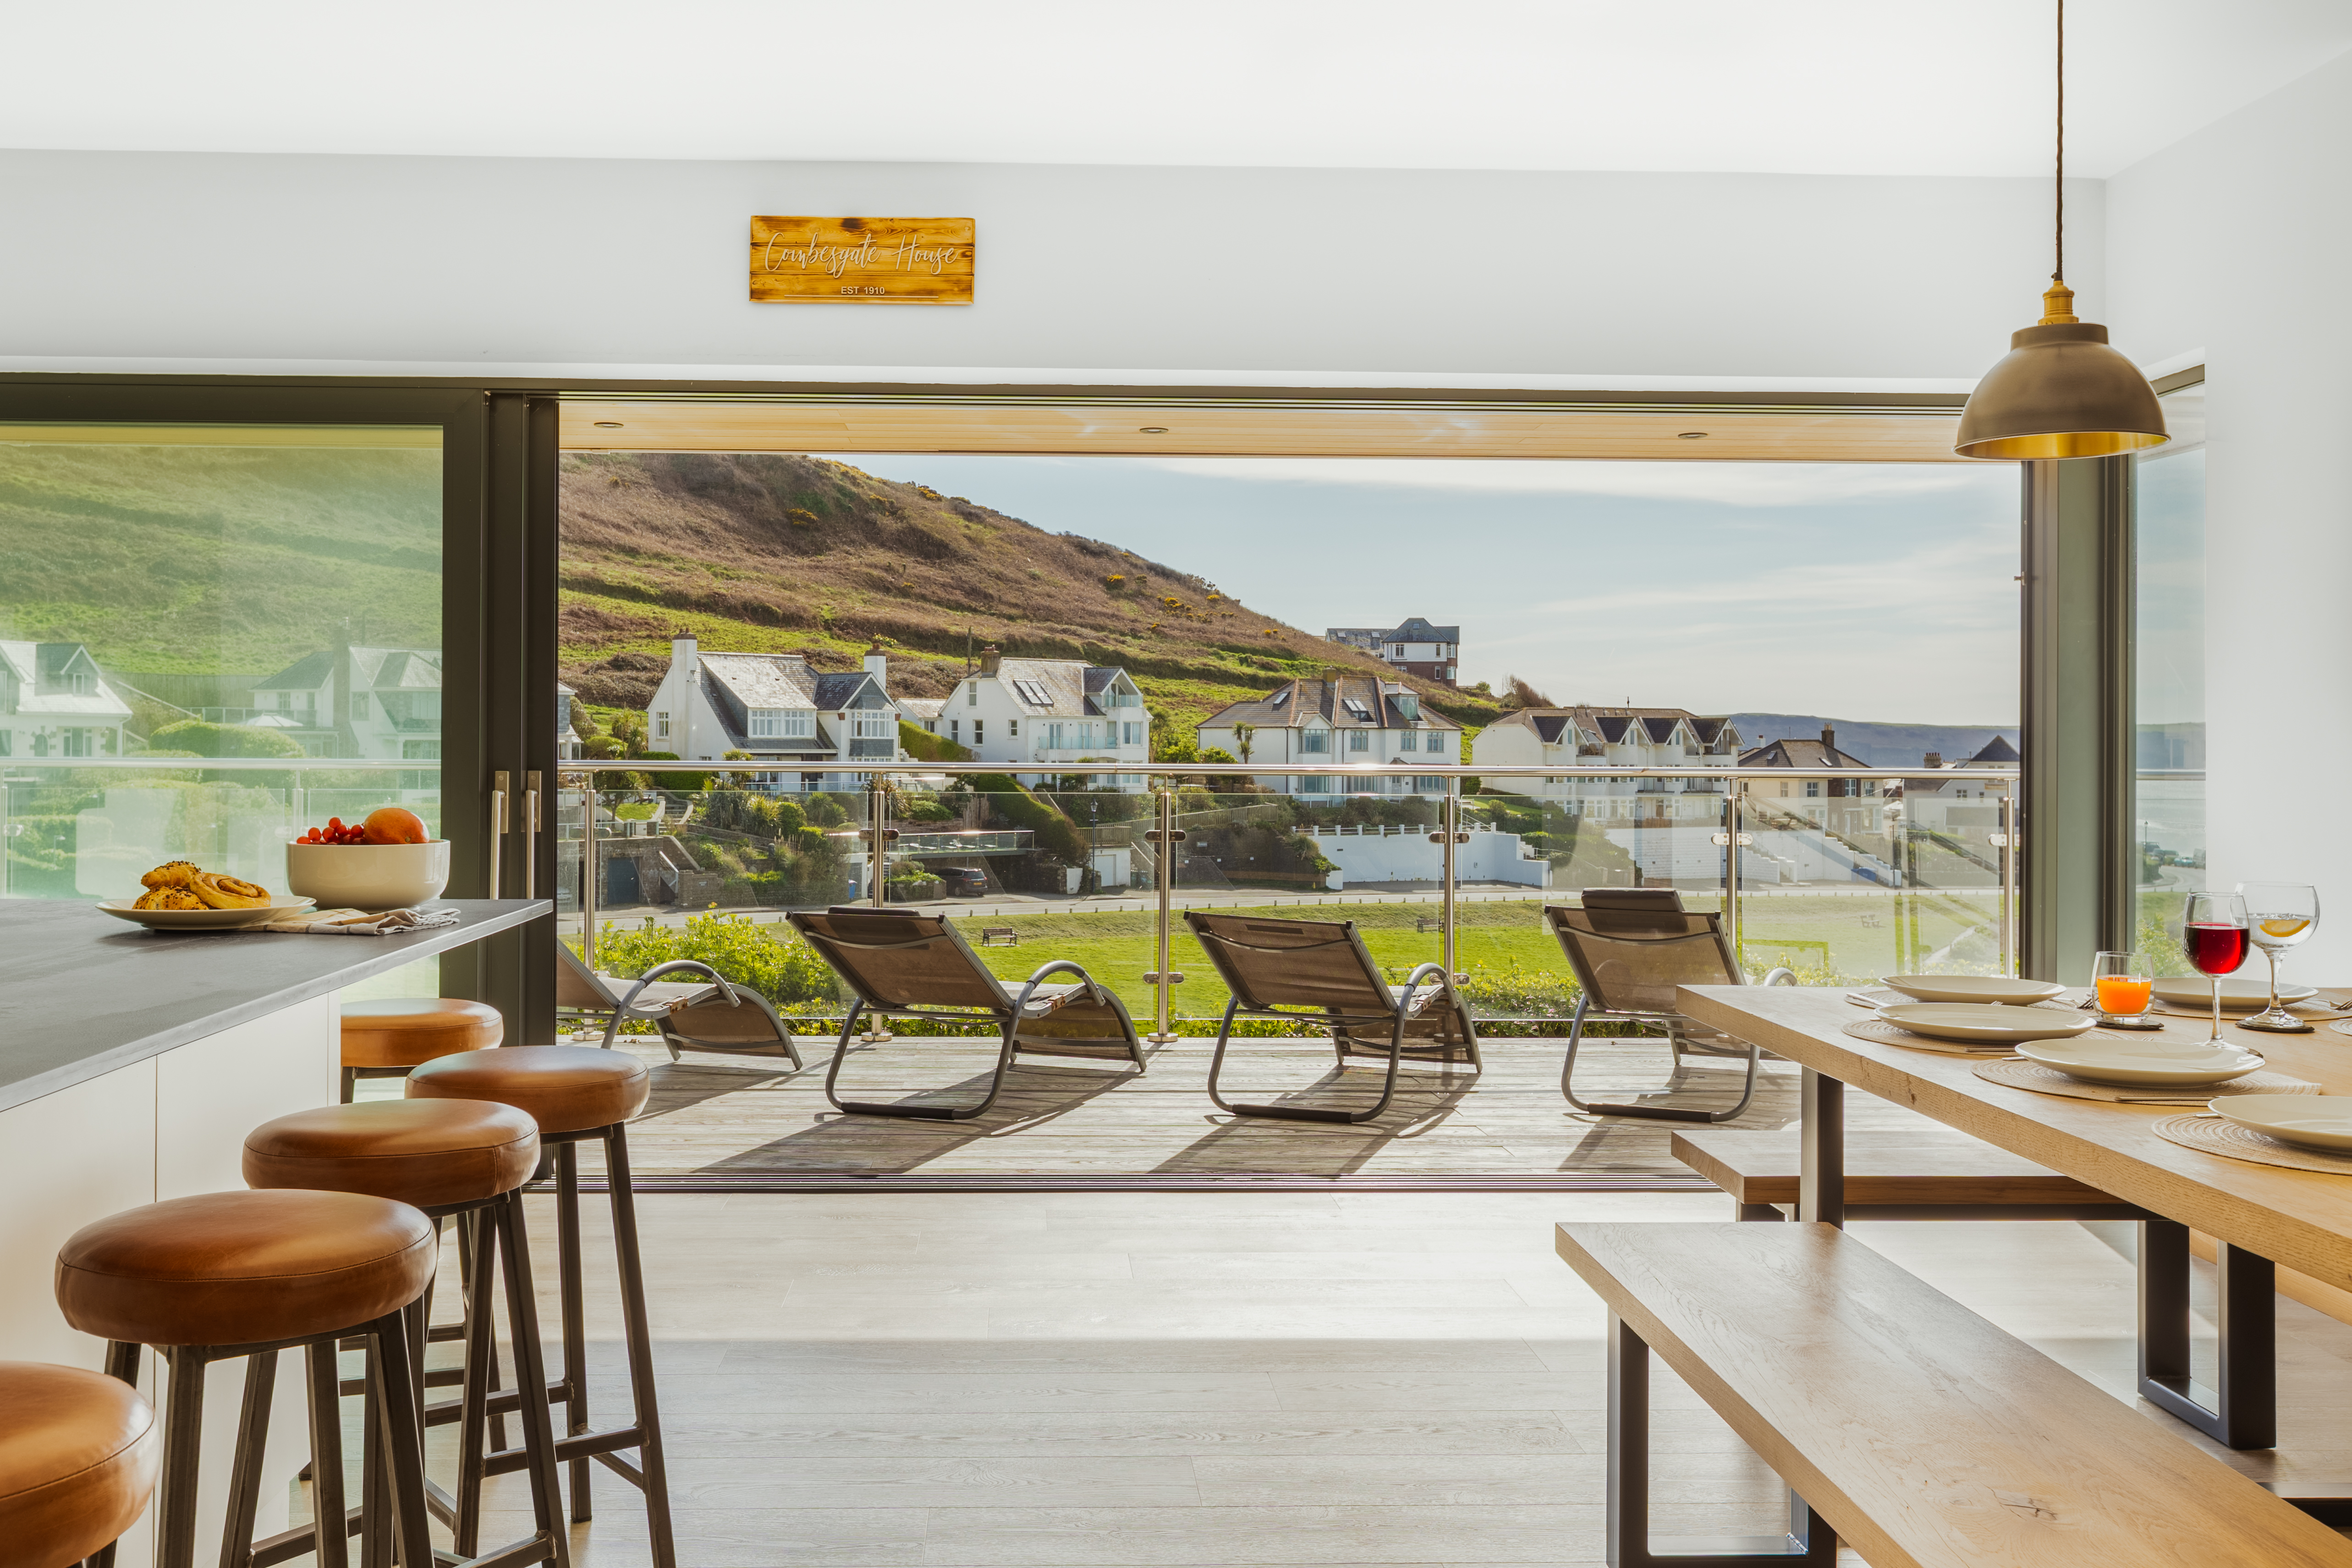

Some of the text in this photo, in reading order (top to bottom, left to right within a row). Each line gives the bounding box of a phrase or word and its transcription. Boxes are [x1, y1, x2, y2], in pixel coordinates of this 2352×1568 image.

[765, 232, 958, 279] Combesgate House
[841, 286, 885, 295] EST 1910
